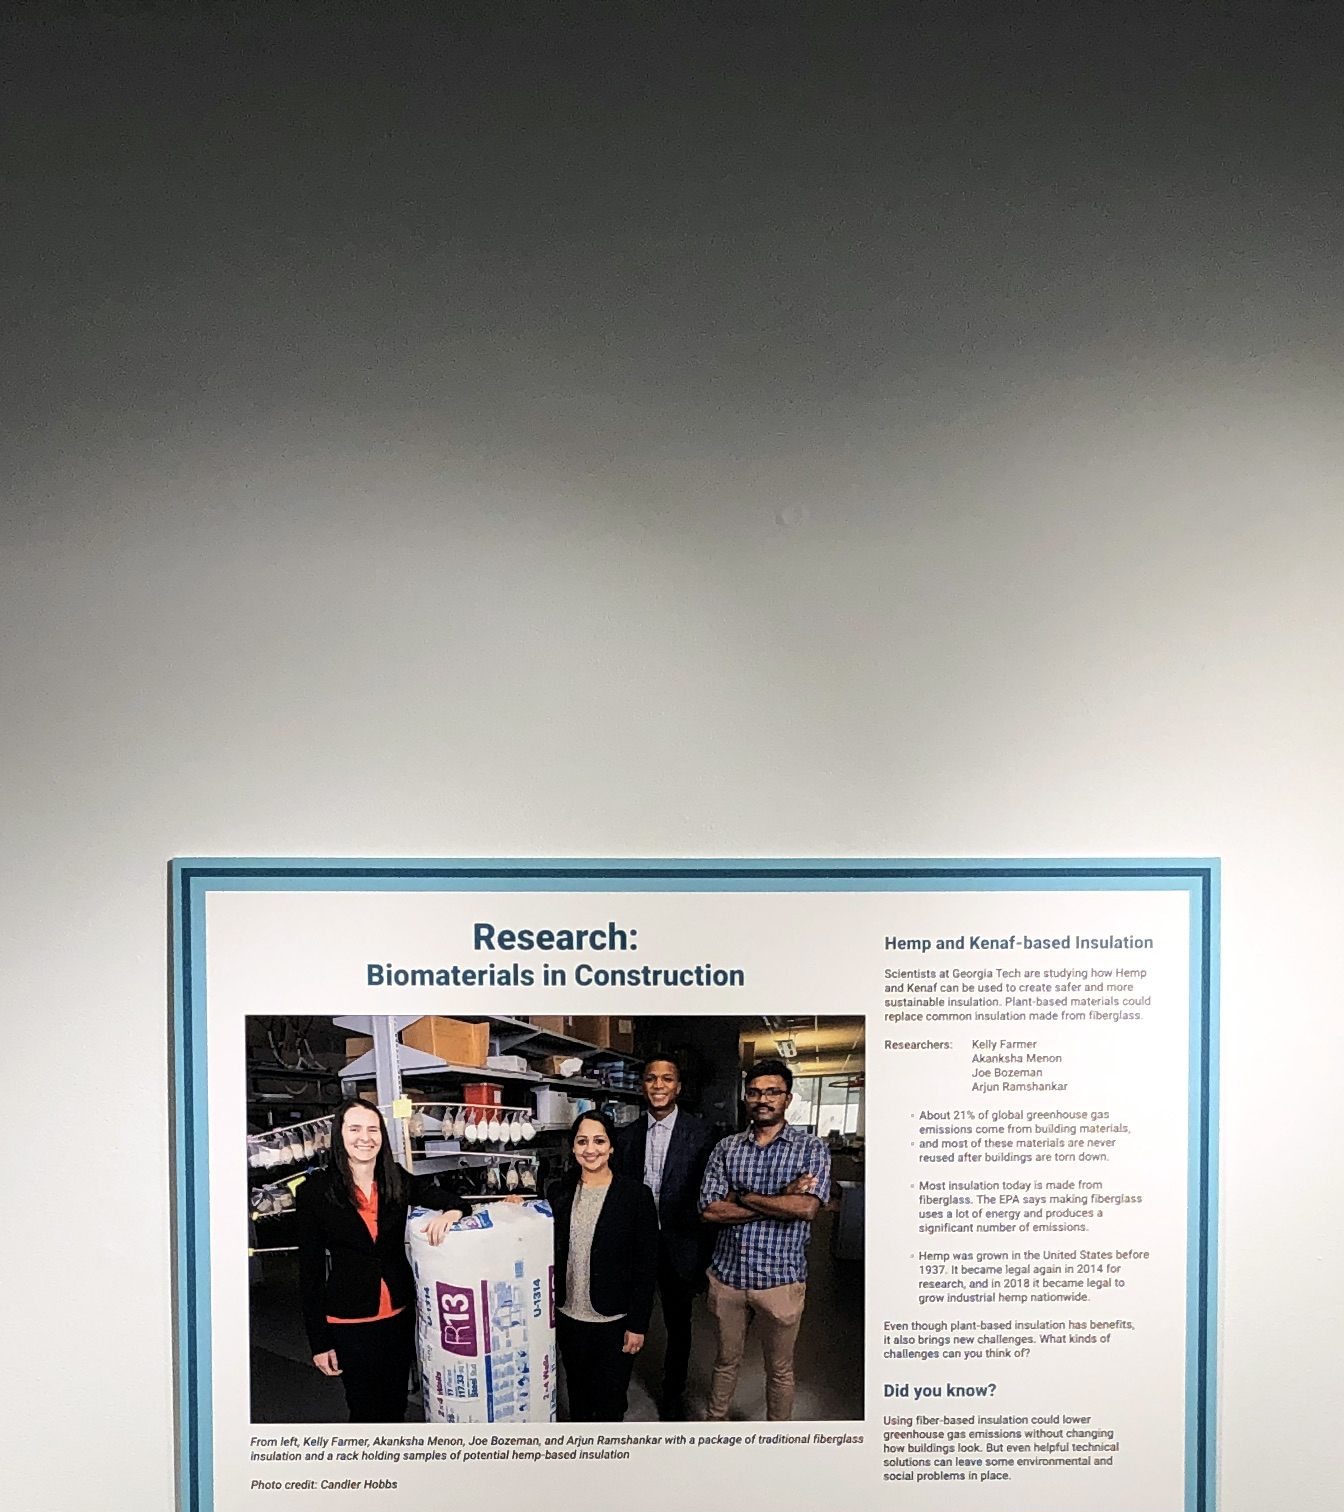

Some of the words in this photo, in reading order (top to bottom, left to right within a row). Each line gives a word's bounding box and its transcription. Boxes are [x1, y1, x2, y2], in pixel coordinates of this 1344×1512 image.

[473, 921, 637, 950] Research:
[884, 936, 931, 953] Hemp
[935, 935, 964, 949] and
[969, 934, 1070, 949] Kenaf-based
[1075, 935, 1153, 949] Insulation
[367, 963, 534, 986] Biomaterials
[543, 963, 568, 986] in
[574, 963, 744, 986] Construction
[884, 968, 936, 978] Scientists
[938, 969, 949, 978] at
[952, 968, 993, 980] Georgia
[995, 968, 1021, 978] Tech
[1023, 970, 1040, 978] are
[1043, 968, 1088, 980] studying
[1090, 968, 1112, 978] how
[1115, 968, 1146, 980] Hemp
[884, 1039, 952, 1049] Researchers:
[971, 1039, 997, 1051] Kelly
[999, 1039, 1037, 1049] Farmer
[971, 1053, 1023, 1063] Akanksha
[1026, 1053, 1062, 1063] Menon
[971, 1068, 991, 1077] Joe
[994, 1068, 1042, 1077] Bozeman
[971, 1081, 999, 1093] Arjun
[1002, 1081, 1068, 1091] Ramshankar
[533, 1278, 542, 1318] U-1314
[442, 1293, 472, 1345] R13
[883, 1383, 909, 1397] Did
[913, 1386, 941, 1400] you
[946, 1383, 996, 1397] know?
[249, 1436, 277, 1446] From
[302, 1436, 329, 1448] Kelly
[330, 1436, 370, 1447] Farmer,
[372, 1436, 424, 1445] Akanksha
[426, 1436, 465, 1447] Menon,
[468, 1436, 488, 1445] Joe
[490, 1436, 541, 1447] Bozeman,
[544, 1435, 564, 1445] and
[565, 1435, 594, 1447] Arjun
[596, 1435, 662, 1445] Ramshankar
[664, 1434, 686, 1444] with
[697, 1434, 742, 1447] package
[744, 1434, 756, 1444] of
[758, 1434, 810, 1444] traditional
[812, 1434, 864, 1446] fiberglass
[250, 1451, 301, 1460] insulation
[304, 1450, 325, 1460] and
[335, 1450, 359, 1460] rack
[361, 1450, 400, 1462] holding
[402, 1450, 447, 1462] samples
[449, 1450, 462, 1460] of
[462, 1450, 509, 1462] potential
[511, 1449, 577, 1461] hemp-based
[578, 1449, 629, 1459] insulation
[250, 1479, 282, 1489] Photo
[284, 1479, 317, 1489] credit:
[320, 1479, 361, 1489] Candler
[363, 1479, 397, 1489] Hobbs
